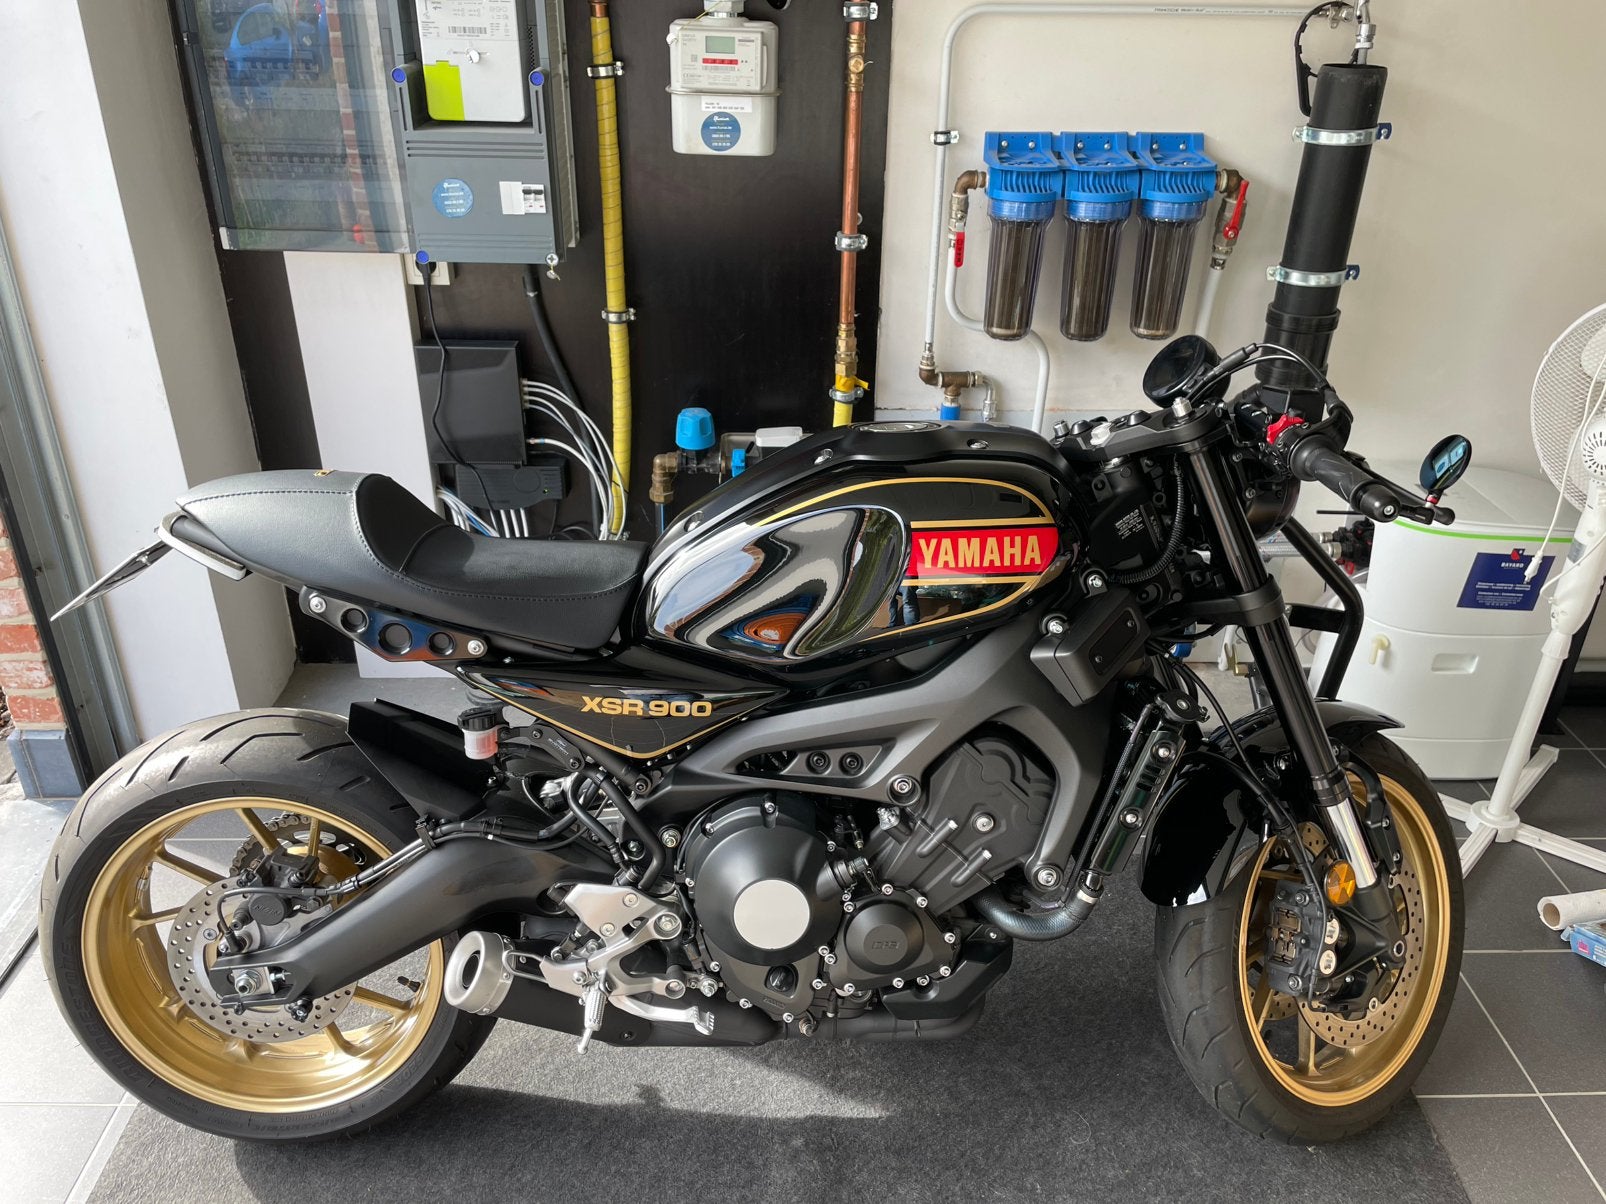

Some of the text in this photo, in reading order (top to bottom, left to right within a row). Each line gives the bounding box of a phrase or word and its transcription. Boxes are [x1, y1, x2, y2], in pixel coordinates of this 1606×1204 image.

[918, 535, 1042, 569] YAMAHA
[581, 696, 712, 717] XSR 900
